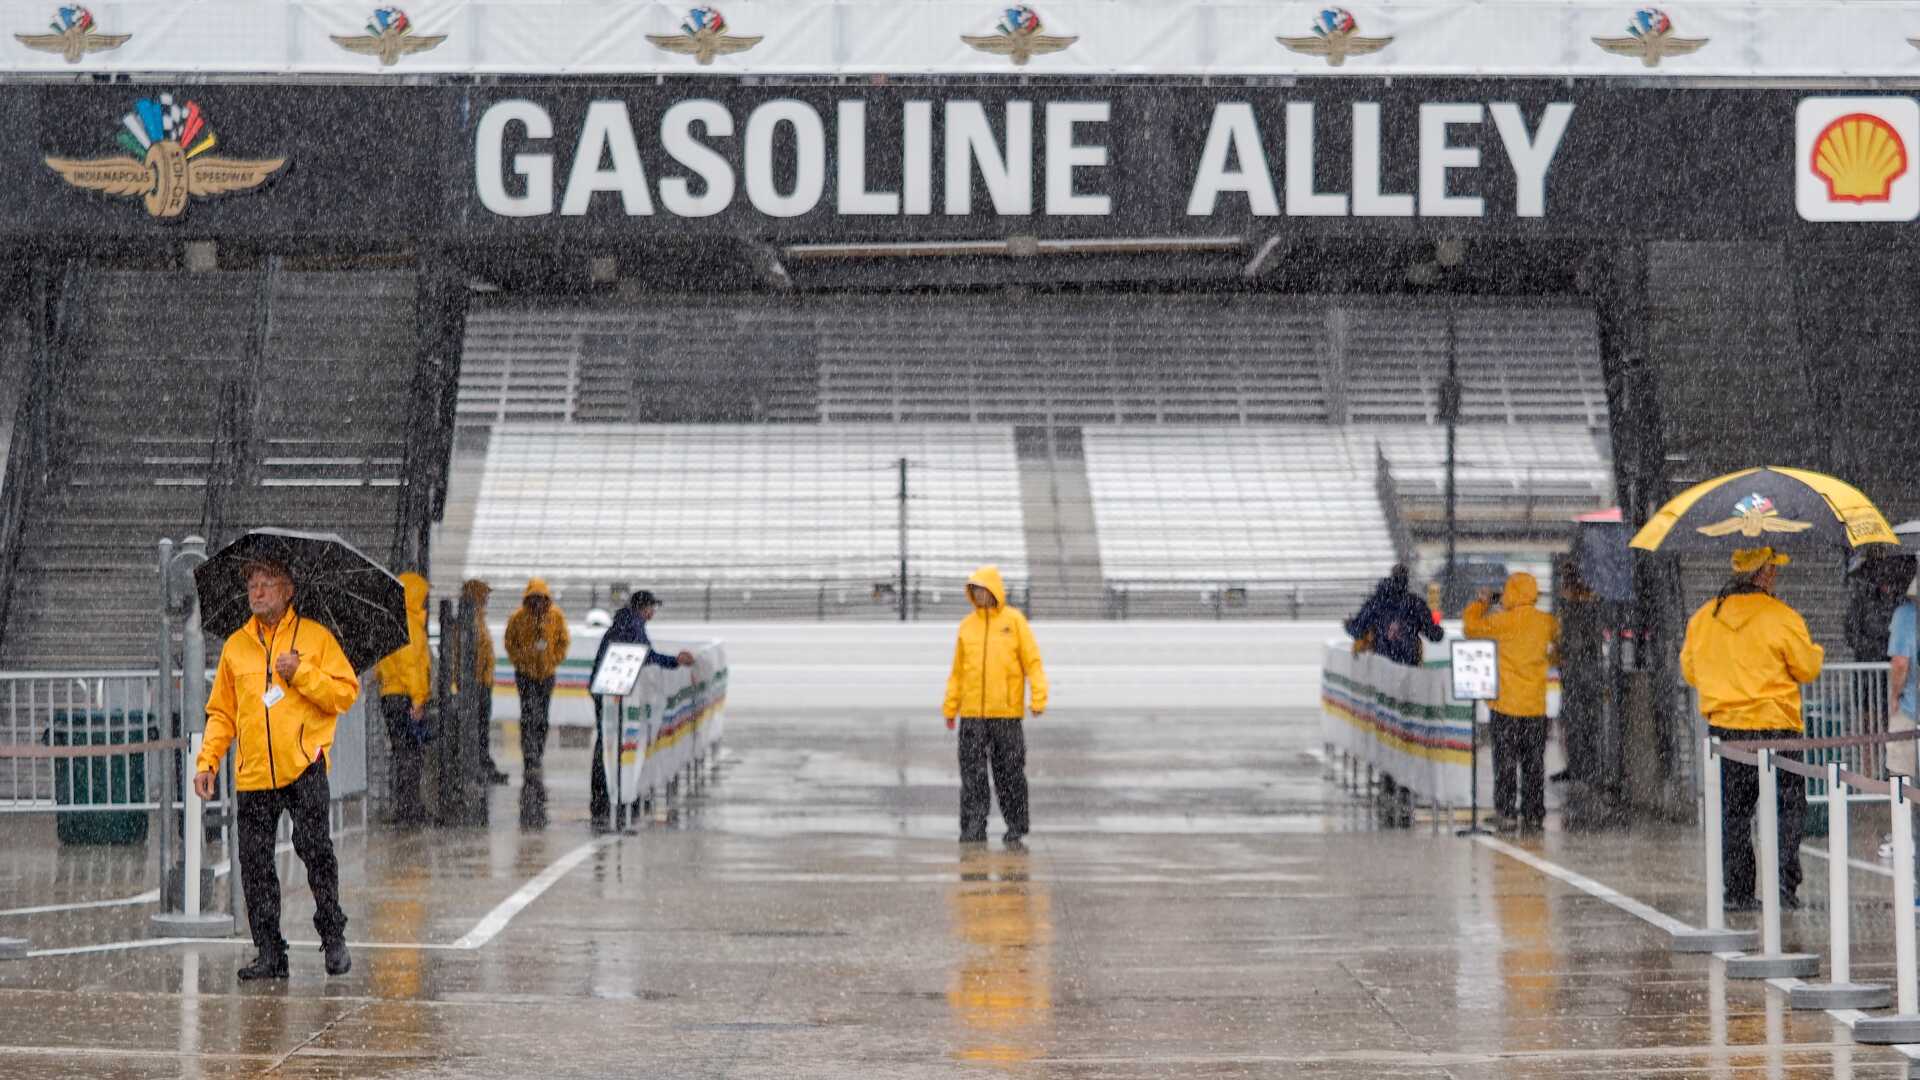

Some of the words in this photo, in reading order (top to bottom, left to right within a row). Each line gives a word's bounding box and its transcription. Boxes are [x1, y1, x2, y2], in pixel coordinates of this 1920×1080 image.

[476, 99, 1112, 218] GASOLINE
[1187, 101, 1575, 218] ALLEY
[73, 170, 150, 183] INDIANAPOLIS
[195, 171, 255, 183] SPEEDWAY
